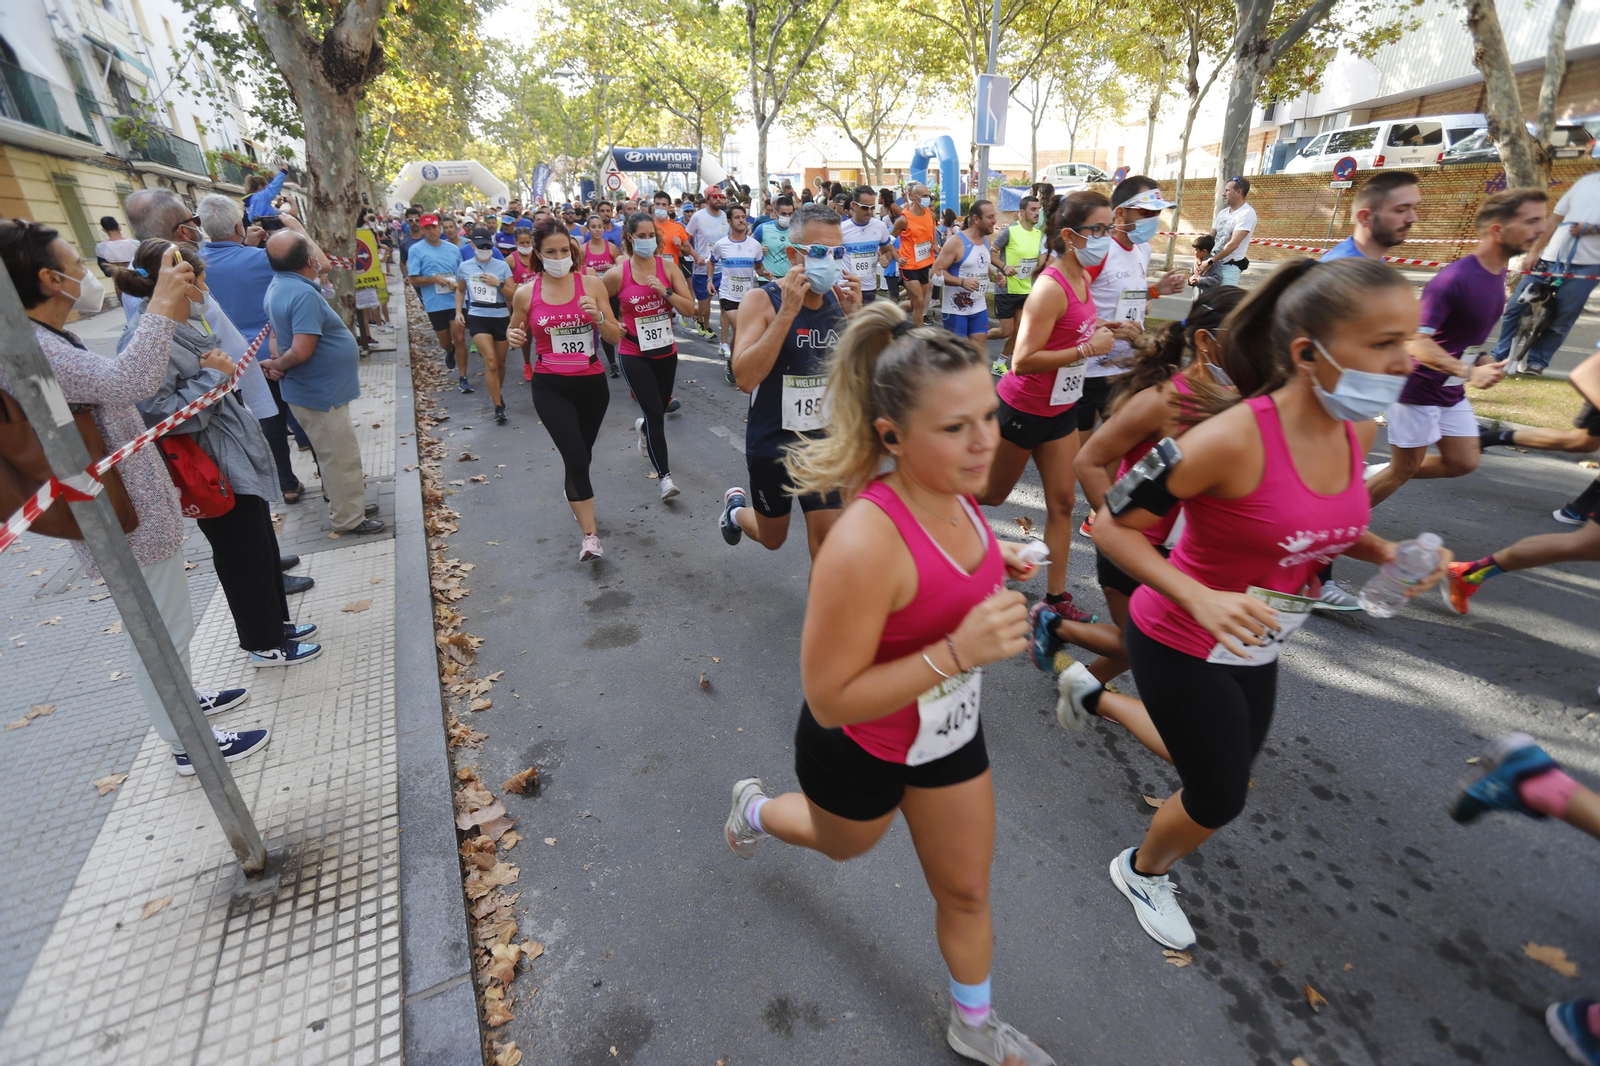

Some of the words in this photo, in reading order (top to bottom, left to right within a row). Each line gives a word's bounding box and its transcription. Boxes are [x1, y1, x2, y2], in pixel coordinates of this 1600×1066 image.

[645, 152, 692, 161] HYUNDAI
[856, 262, 869, 270] 669
[473, 286, 487, 295] 199
[731, 284, 744, 292] 390
[645, 327, 662, 341] 387
[796, 328, 840, 348] FILA
[561, 341, 585, 354] 382
[796, 378, 815, 387] VUELTA
[816, 378, 820, 386] A
[795, 397, 821, 416] 185
